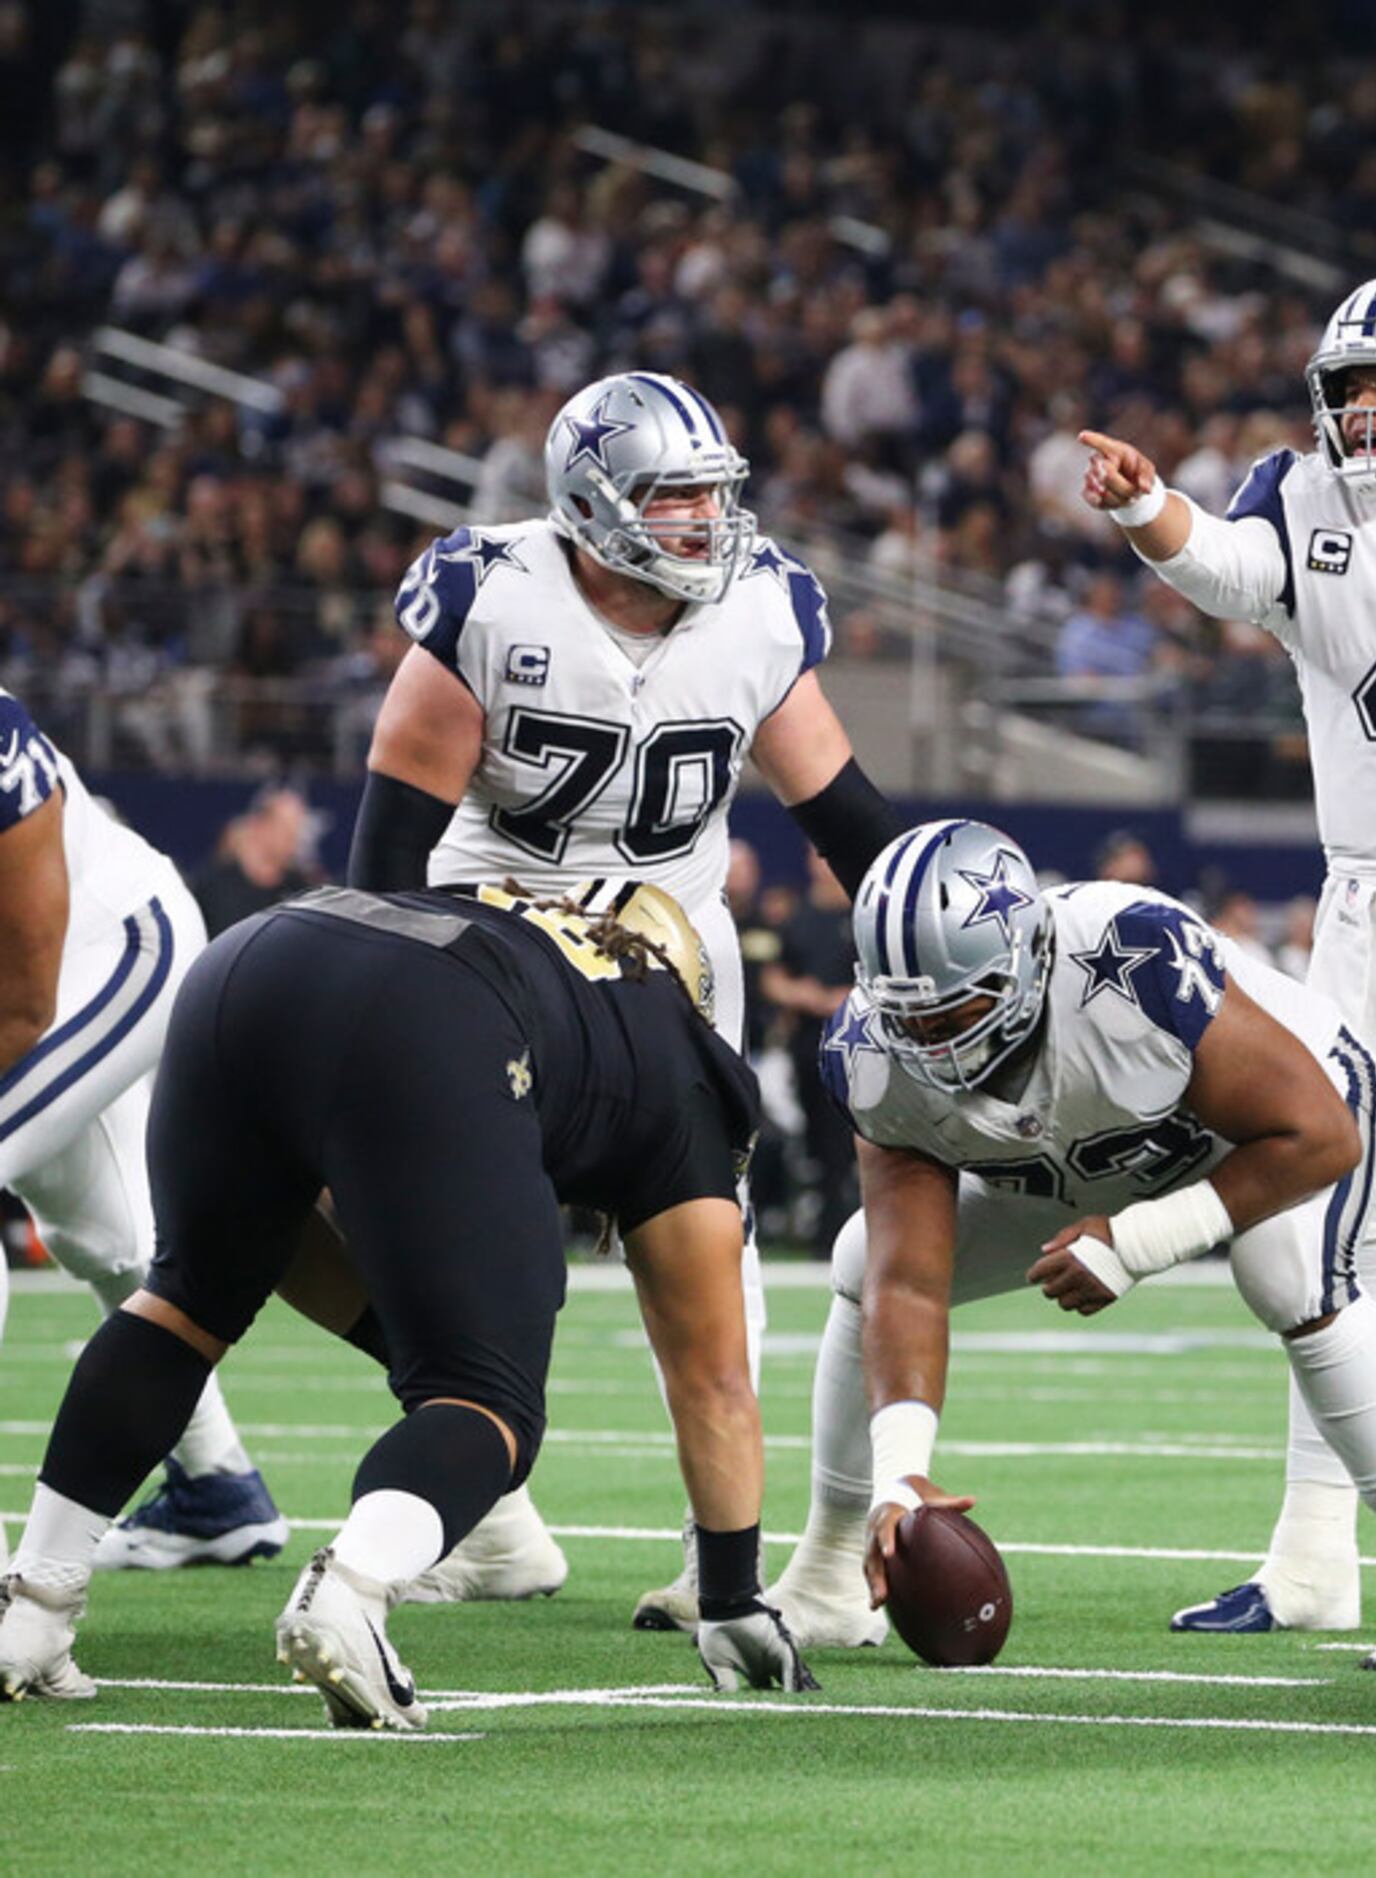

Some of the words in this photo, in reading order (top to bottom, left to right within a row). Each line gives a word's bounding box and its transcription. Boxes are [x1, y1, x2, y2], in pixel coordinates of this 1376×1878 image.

[1310, 531, 1351, 563] C
[509, 646, 549, 677] C
[487, 704, 747, 867] 70
